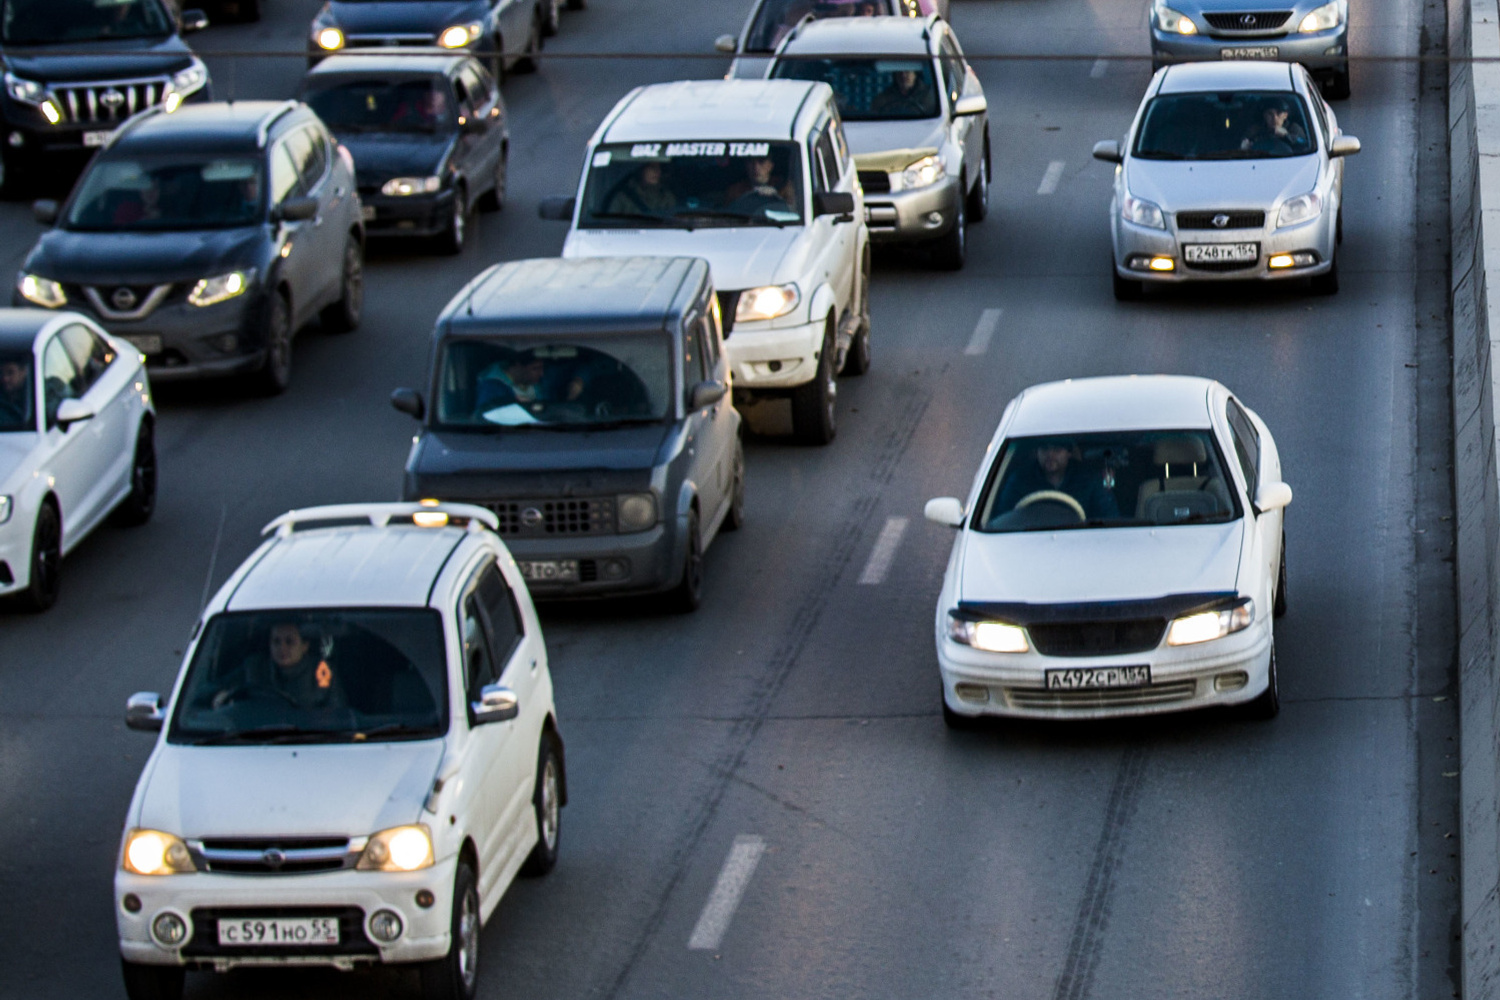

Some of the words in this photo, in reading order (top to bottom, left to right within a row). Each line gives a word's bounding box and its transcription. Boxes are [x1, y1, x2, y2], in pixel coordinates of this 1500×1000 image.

[665, 142, 726, 157] MASTER
[728, 142, 770, 157] TEAM
[1051, 668, 1117, 688] А492СР
[226, 920, 308, 941] С591НО
[310, 920, 332, 939] 55
